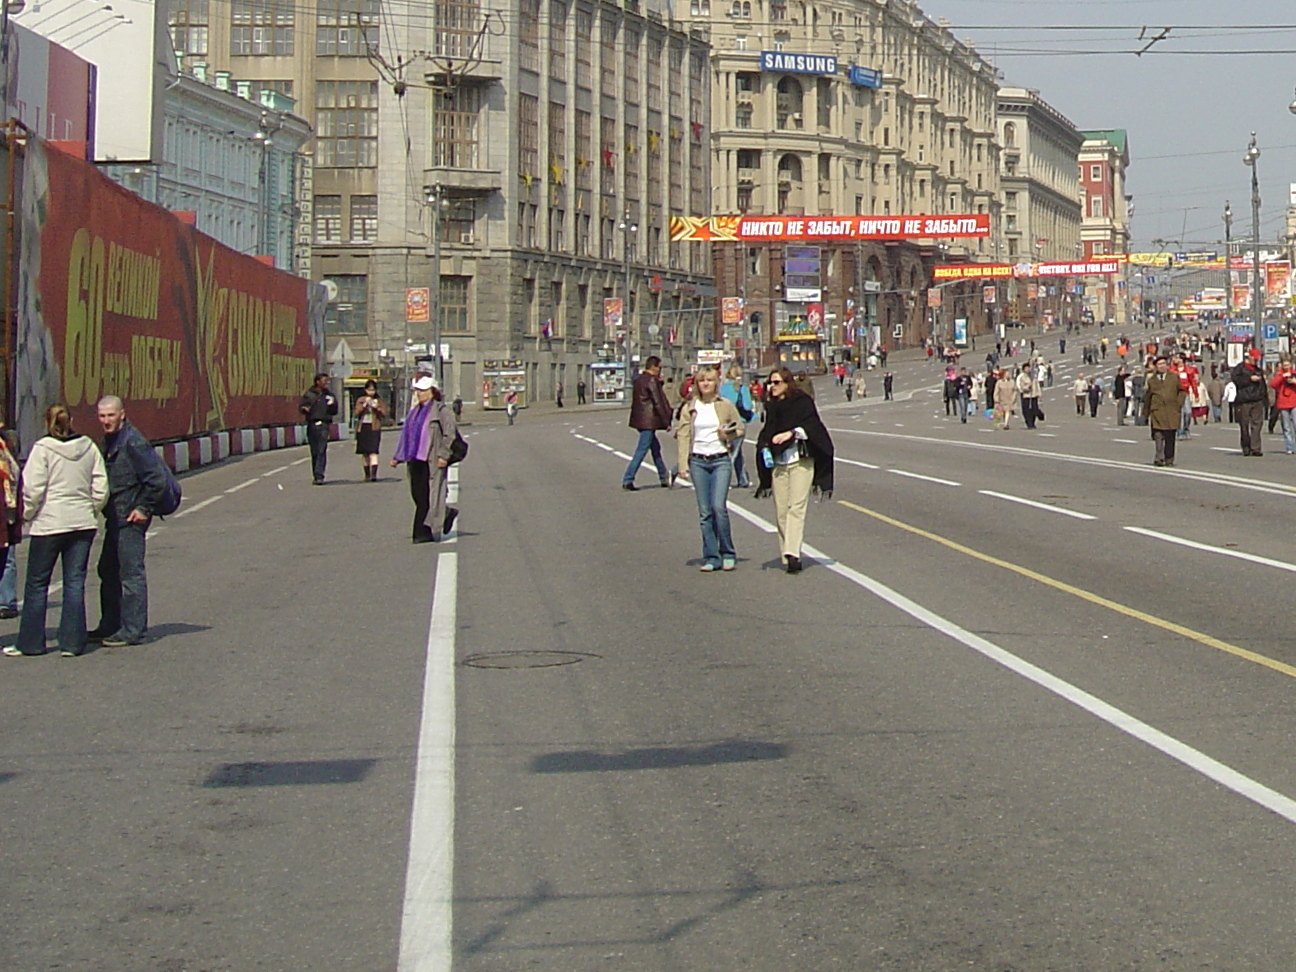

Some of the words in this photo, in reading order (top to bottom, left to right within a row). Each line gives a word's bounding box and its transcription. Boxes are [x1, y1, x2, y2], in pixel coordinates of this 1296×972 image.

[764, 53, 836, 73] SAMSUNG
[741, 220, 783, 236] НИКТО
[786, 220, 804, 236] НЕ
[807, 220, 856, 237] ЗАБЫТ,
[858, 219, 901, 235] НИЧТО
[904, 219, 922, 234] НЕ
[106, 240, 161, 320] ВЕЛИКОЙ
